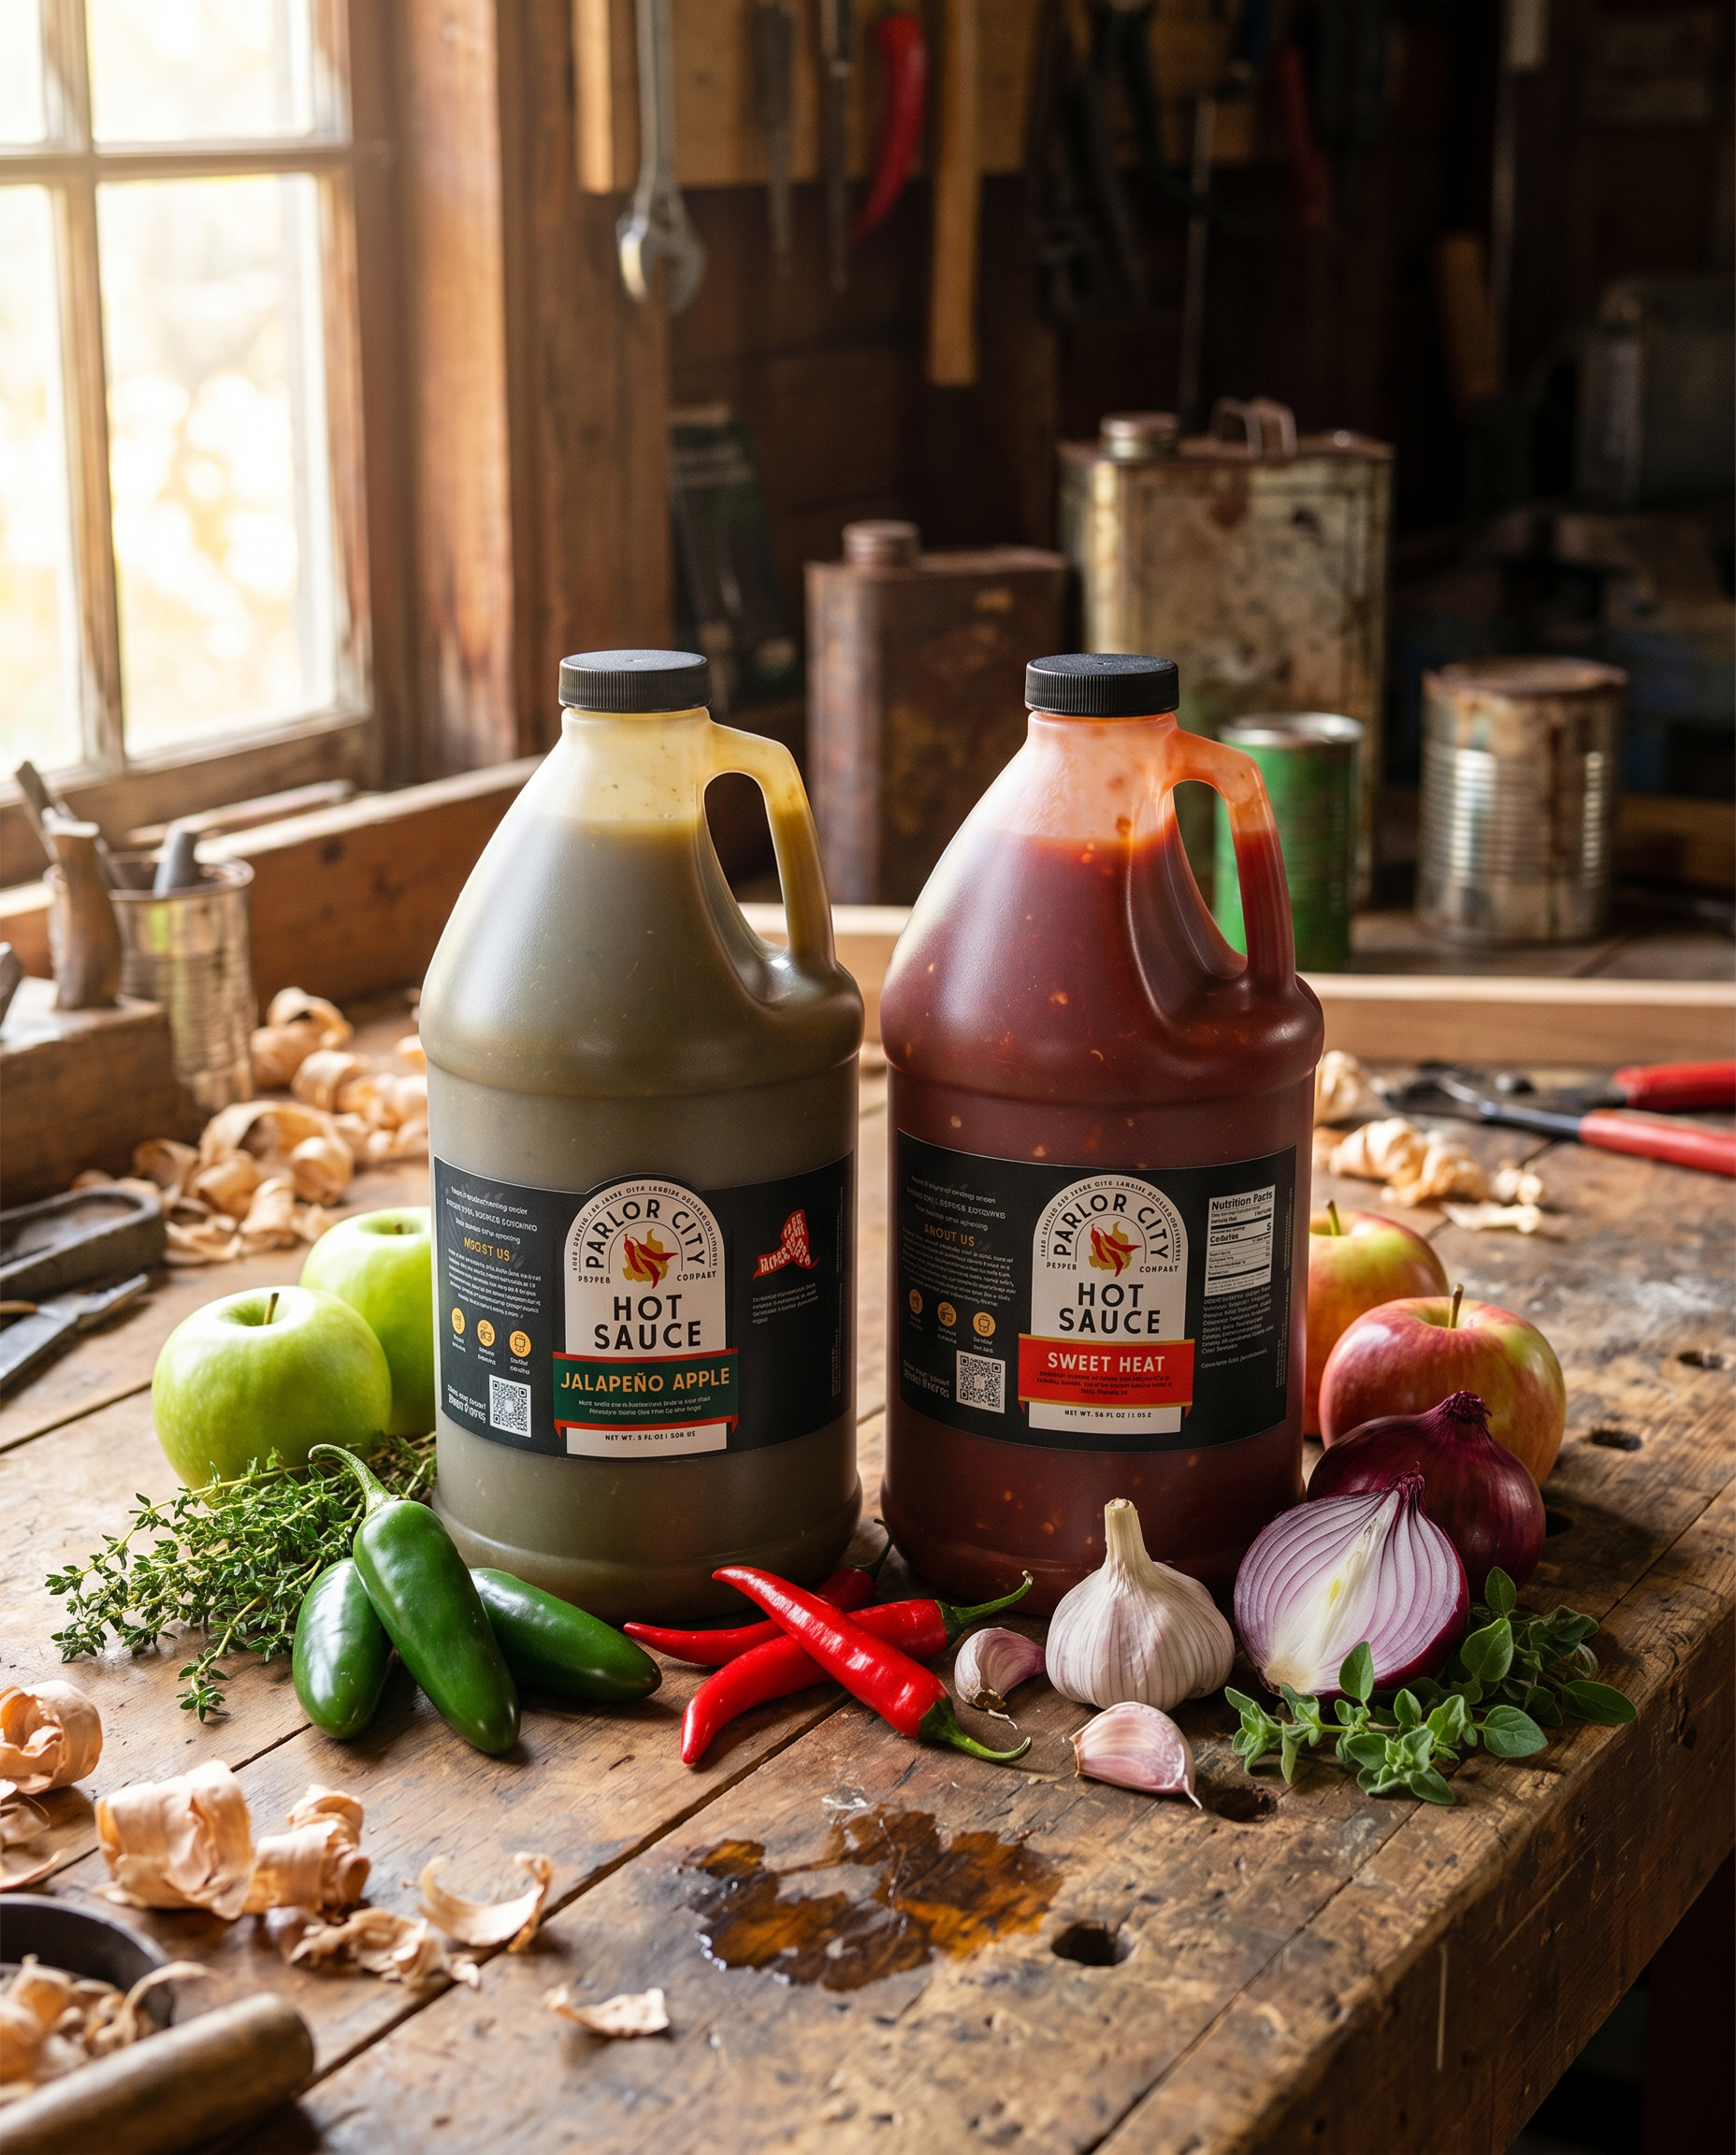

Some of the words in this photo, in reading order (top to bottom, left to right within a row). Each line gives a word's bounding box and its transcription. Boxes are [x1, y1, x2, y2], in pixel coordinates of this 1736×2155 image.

[586, 1198, 660, 1269] PARLOR
[672, 1210, 705, 1266] CITY
[1053, 1193, 1128, 1256] PARLOR
[1136, 1207, 1169, 1260] CITY
[960, 1234, 976, 1248] US
[497, 1248, 510, 1262] US
[614, 1294, 683, 1321] HOT
[1078, 1282, 1144, 1308] HOT
[1059, 1308, 1161, 1335] SAUCE
[594, 1321, 702, 1350] SAUCE
[1048, 1352, 1111, 1372] SWEET
[1119, 1355, 1165, 1373] HEAT
[560, 1372, 664, 1393] JALAPEÑO
[673, 1367, 730, 1391] APPLE
